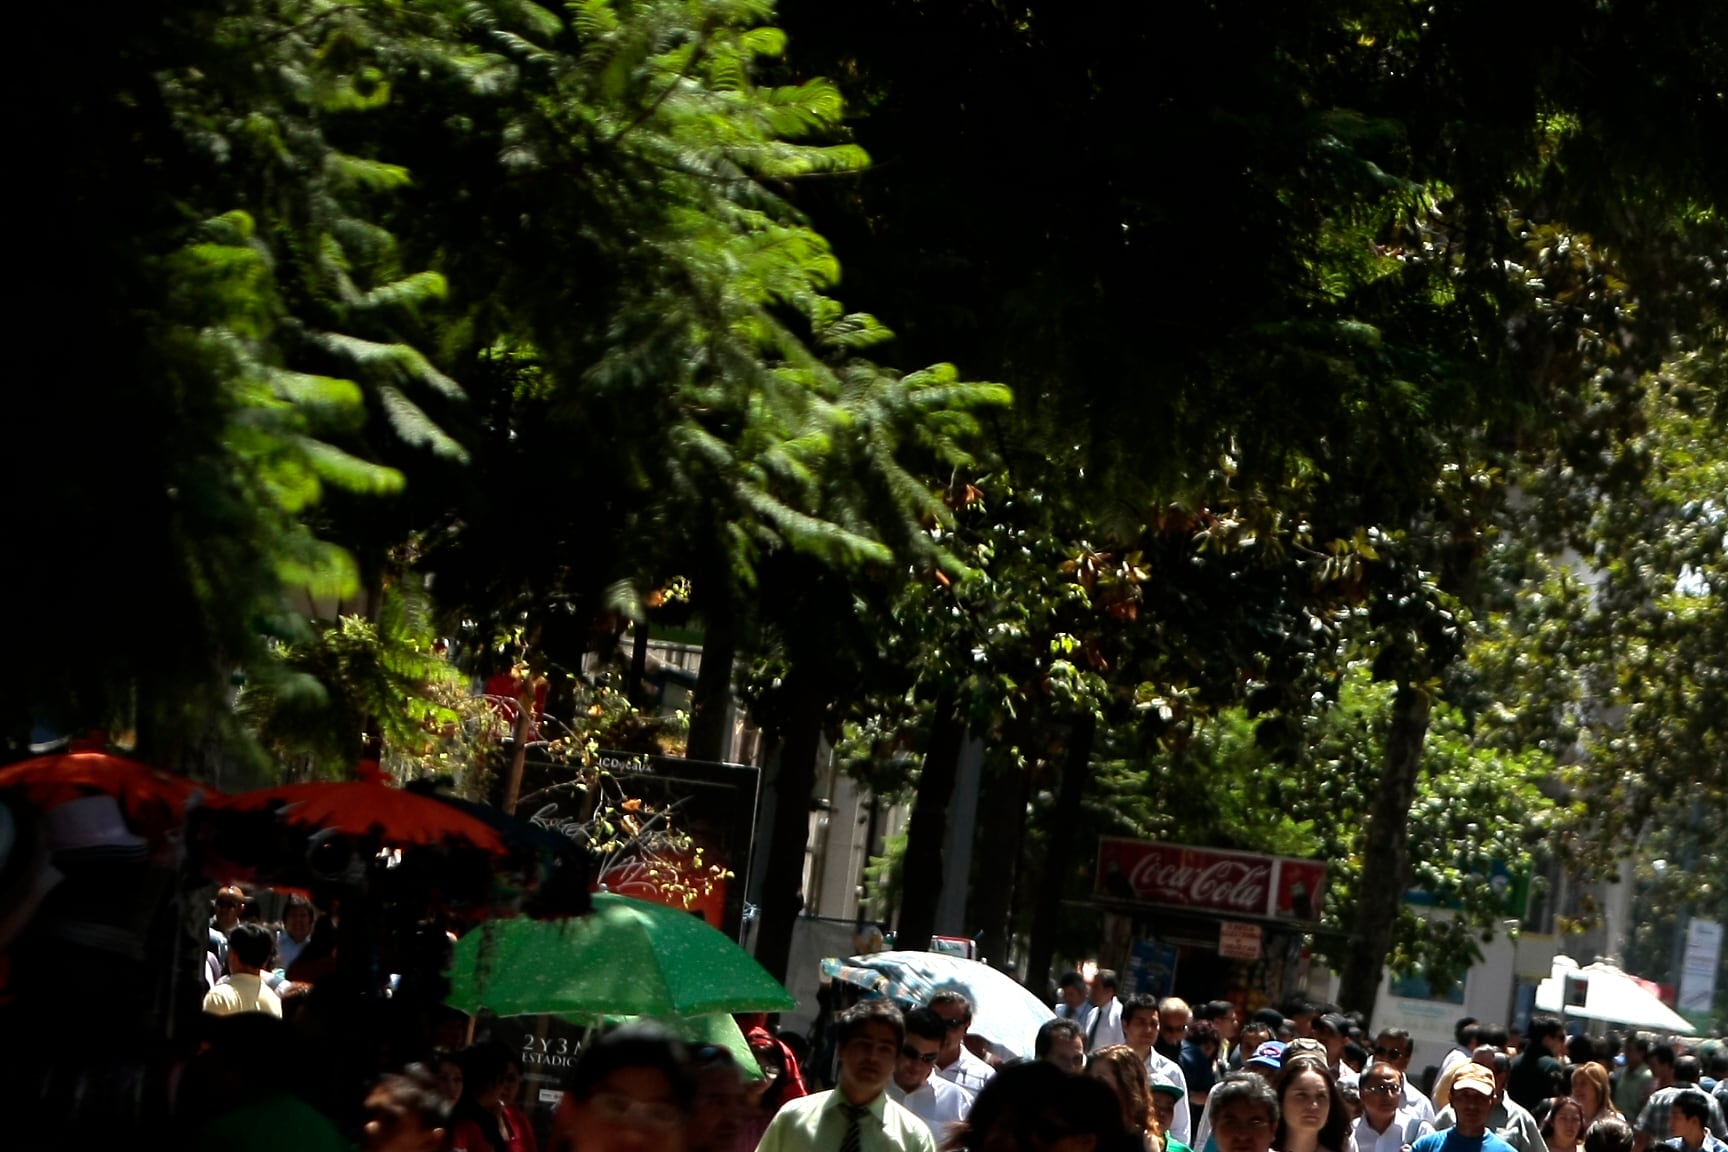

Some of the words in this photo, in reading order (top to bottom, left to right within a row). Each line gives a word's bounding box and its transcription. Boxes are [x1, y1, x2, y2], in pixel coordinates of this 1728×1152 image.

[522, 1033, 535, 1050] 2
[540, 1037, 552, 1053] Y
[556, 1037, 568, 1054] 3
